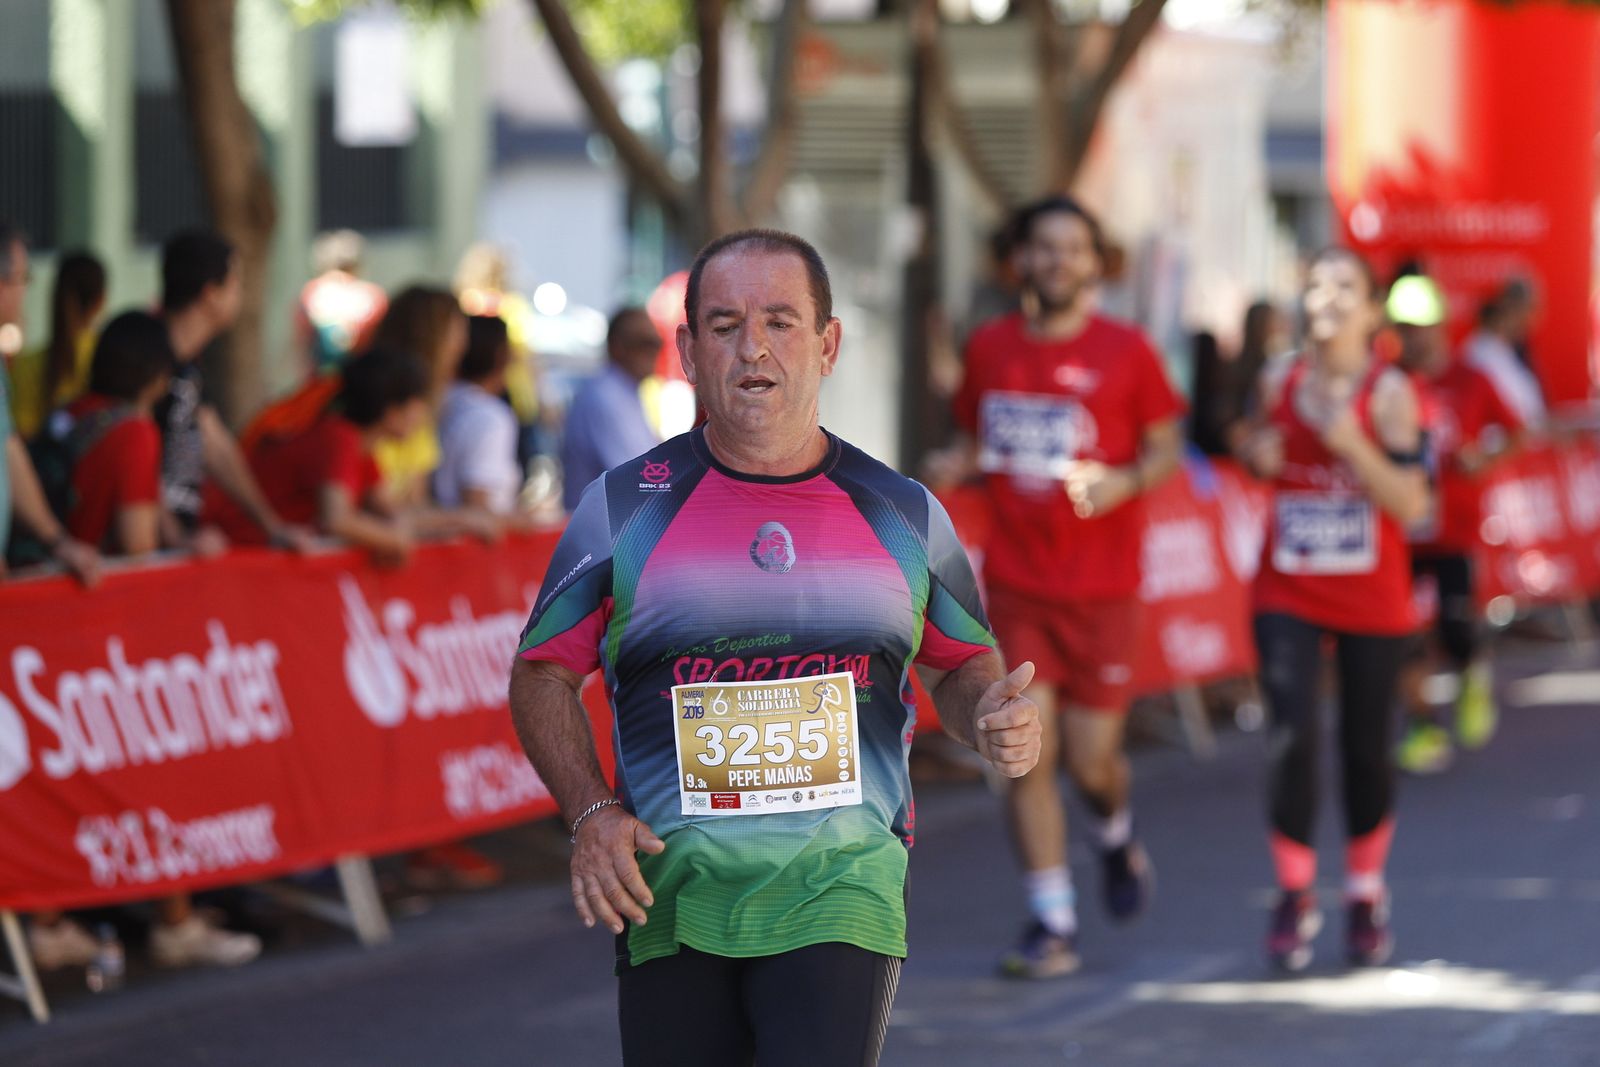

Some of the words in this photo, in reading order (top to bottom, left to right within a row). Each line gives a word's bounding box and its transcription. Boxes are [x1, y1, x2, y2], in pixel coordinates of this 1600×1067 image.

[714, 632, 793, 655] Deportivo
[12, 617, 291, 780] Santander
[681, 690, 705, 699] ALMERIA
[737, 687, 801, 701] CARRERA
[682, 705, 705, 719] 2019
[737, 698, 802, 712] SOLIDARIA
[695, 718, 830, 767] 3255
[728, 769, 762, 787] PEPE
[765, 763, 813, 786] MAÑAS
